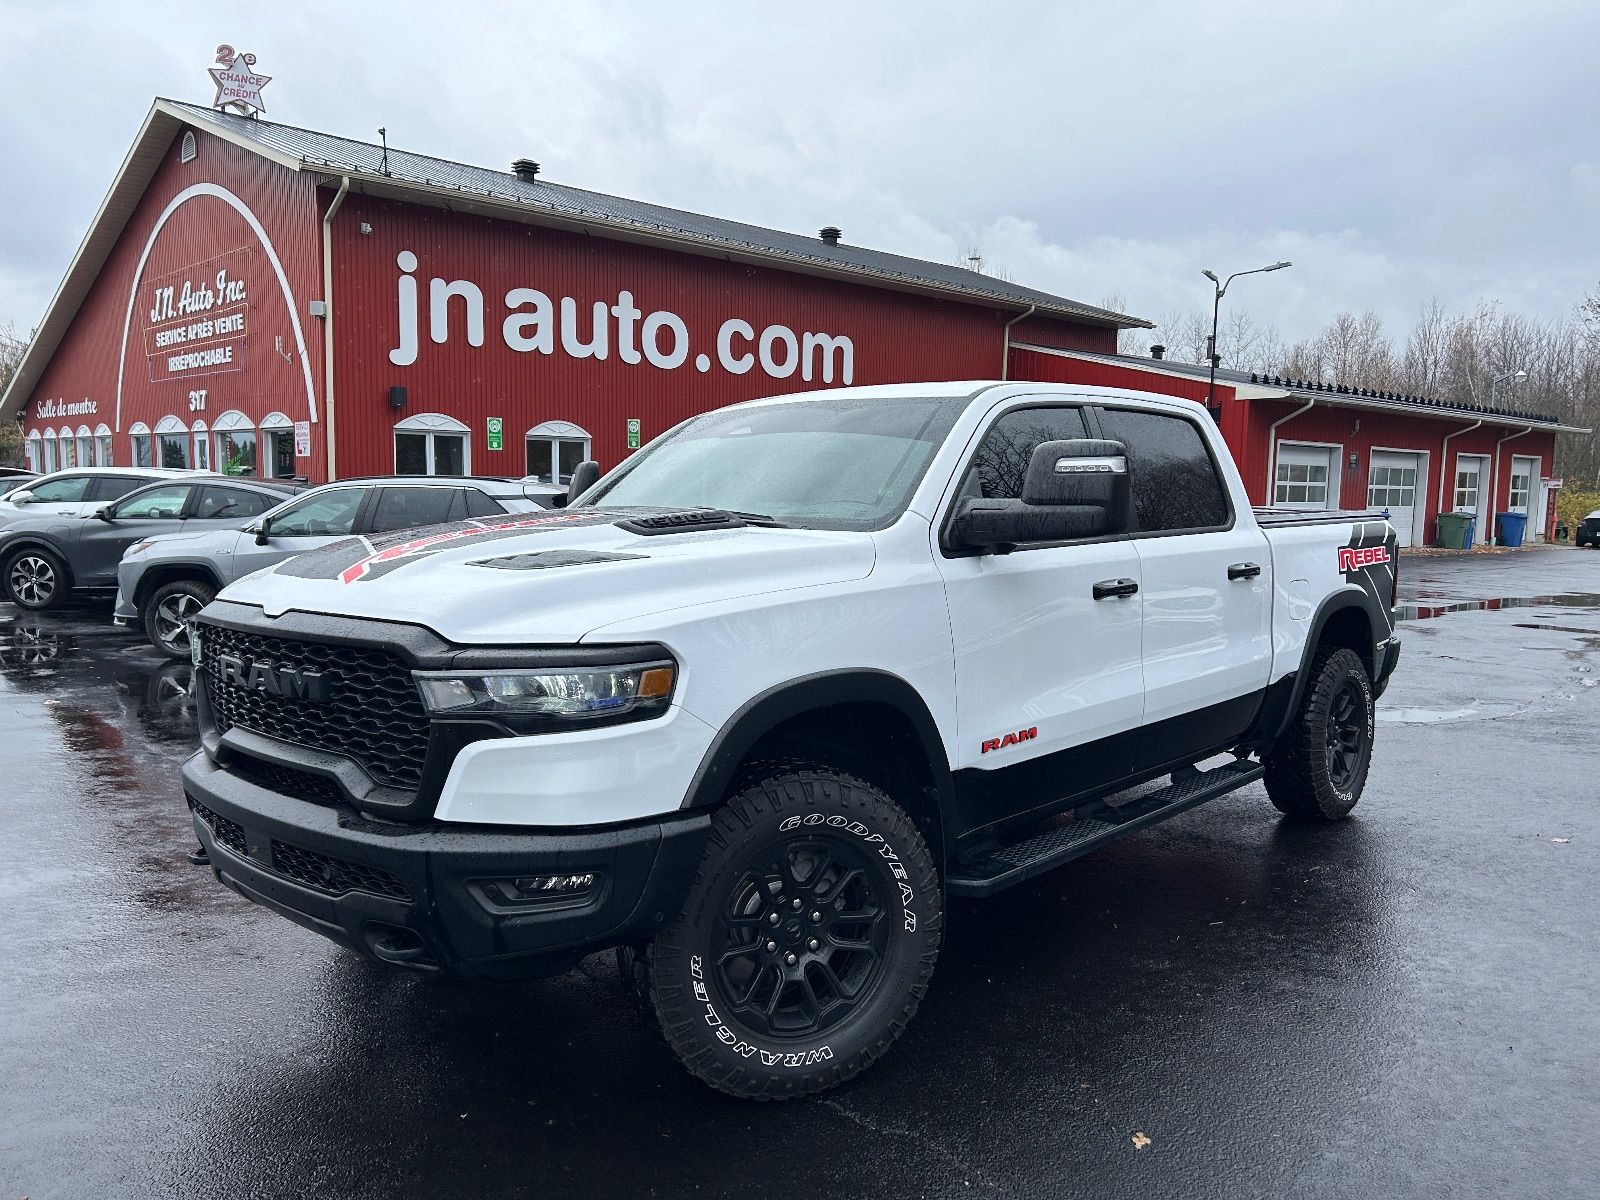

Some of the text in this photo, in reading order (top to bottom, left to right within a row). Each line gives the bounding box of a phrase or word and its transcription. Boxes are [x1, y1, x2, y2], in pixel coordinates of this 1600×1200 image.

[219, 72, 262, 86] CHANCE
[178, 280, 214, 315] Auto
[216, 269, 246, 305] Inc.
[155, 313, 244, 347] SERVICE APRÈS VENTE
[168, 346, 233, 372] IRRÉPROCHABLE
[36, 396, 98, 419] Salle de montre
[189, 389, 207, 411] 317
[1339, 546, 1390, 571] REBEL
[219, 653, 321, 699] RAM
[981, 726, 1038, 753] RAM
[779, 813, 916, 933] GOODYEAR
[690, 955, 833, 1067] WRANGLER
